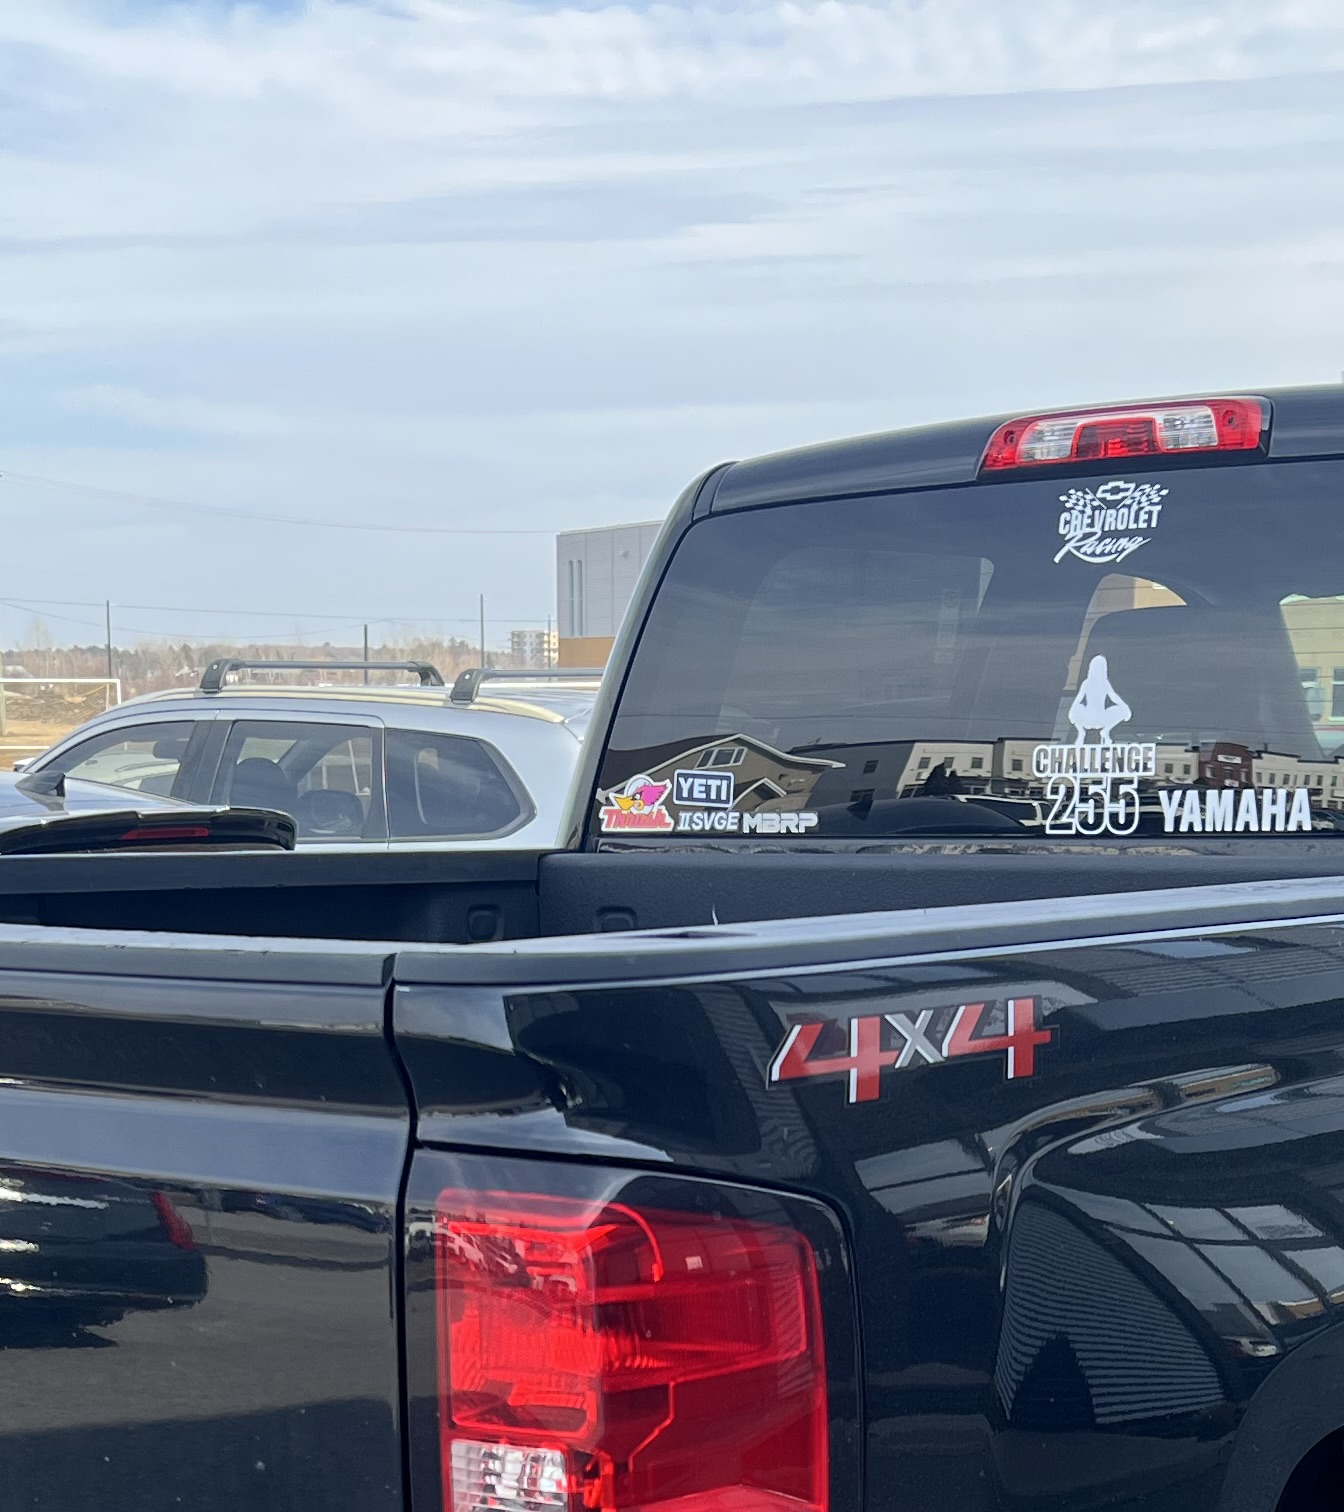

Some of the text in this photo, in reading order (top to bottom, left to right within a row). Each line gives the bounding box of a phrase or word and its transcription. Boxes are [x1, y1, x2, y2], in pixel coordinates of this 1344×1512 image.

[1058, 504, 1162, 535] CHEVROLET
[1053, 527, 1152, 563] Racing
[1032, 742, 1156, 777] CHALLENGE
[678, 777, 729, 800] YETI
[1045, 774, 1140, 835] 255
[743, 812, 819, 834] MBRP
[1159, 788, 1313, 832] YAMAHA
